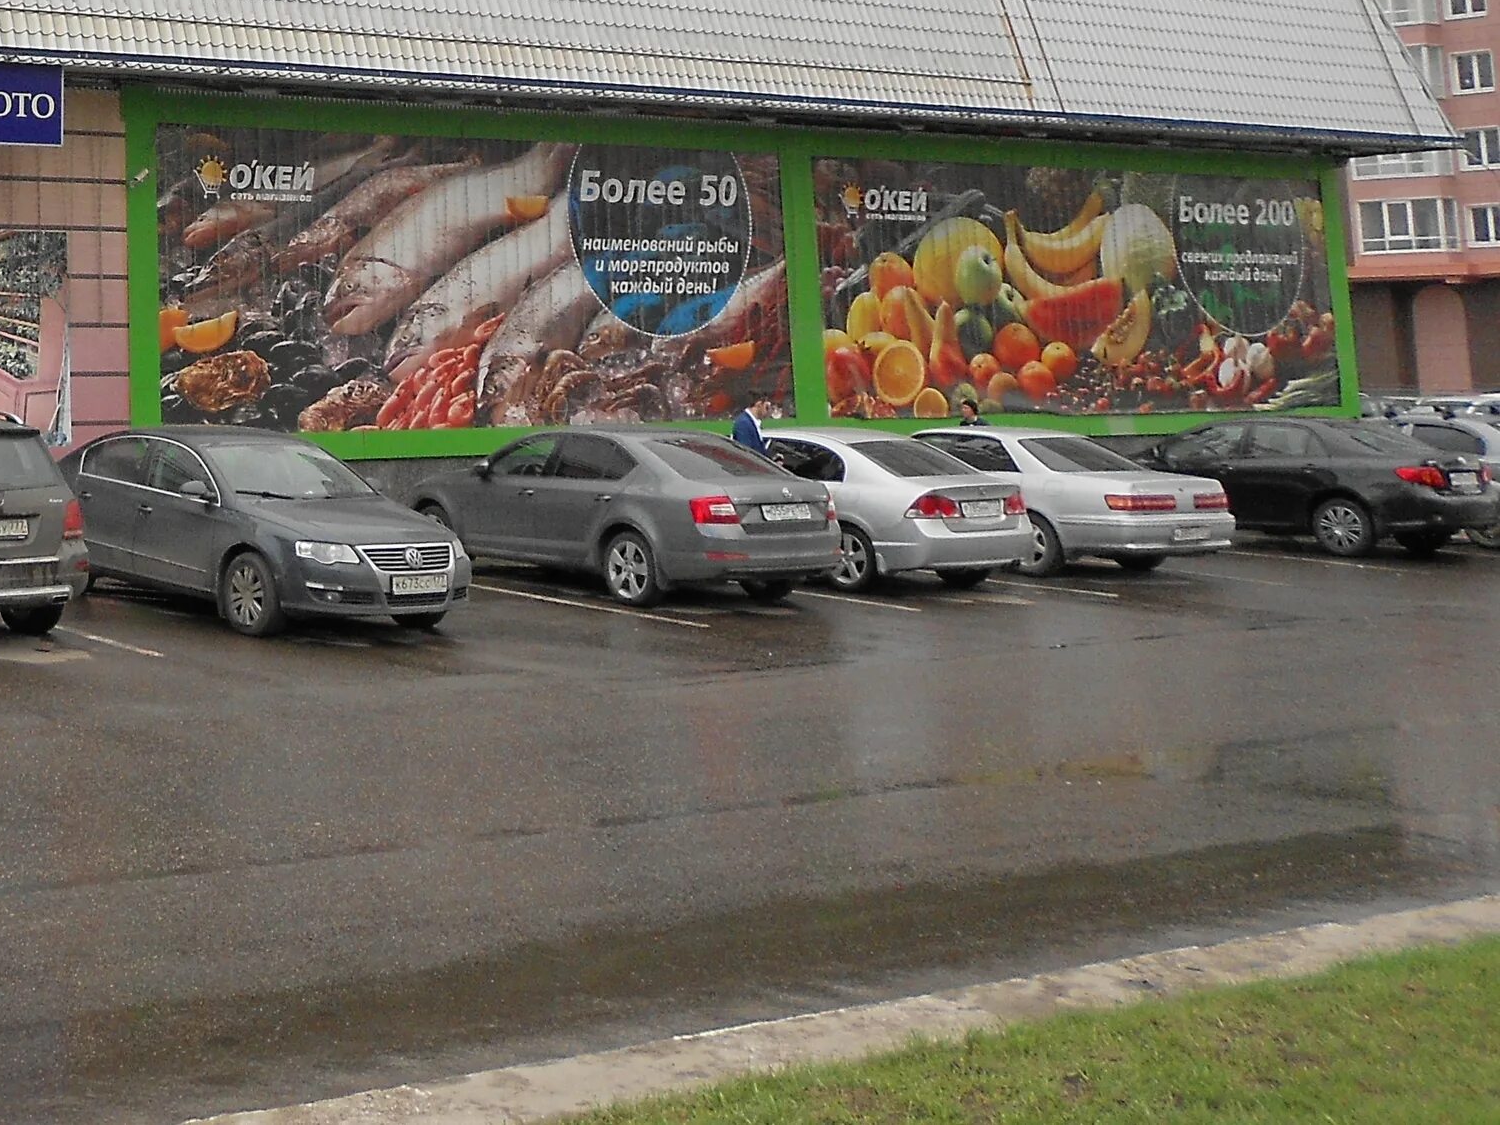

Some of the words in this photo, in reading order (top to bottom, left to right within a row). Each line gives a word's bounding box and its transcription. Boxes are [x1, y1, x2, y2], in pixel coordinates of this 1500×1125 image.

[230, 192, 254, 201] сеть
[580, 169, 686, 205] Более
[699, 175, 738, 207] 50
[1179, 195, 1250, 225] Более
[1255, 198, 1295, 226] 200
[583, 235, 694, 252] наименований
[696, 236, 739, 256] рыбы
[595, 258, 604, 273] и
[607, 256, 730, 277] морепродуктов
[1181, 251, 1223, 263] свежих
[1204, 266, 1251, 281] каждый
[611, 277, 673, 294] каждый
[676, 277, 717, 295] день!
